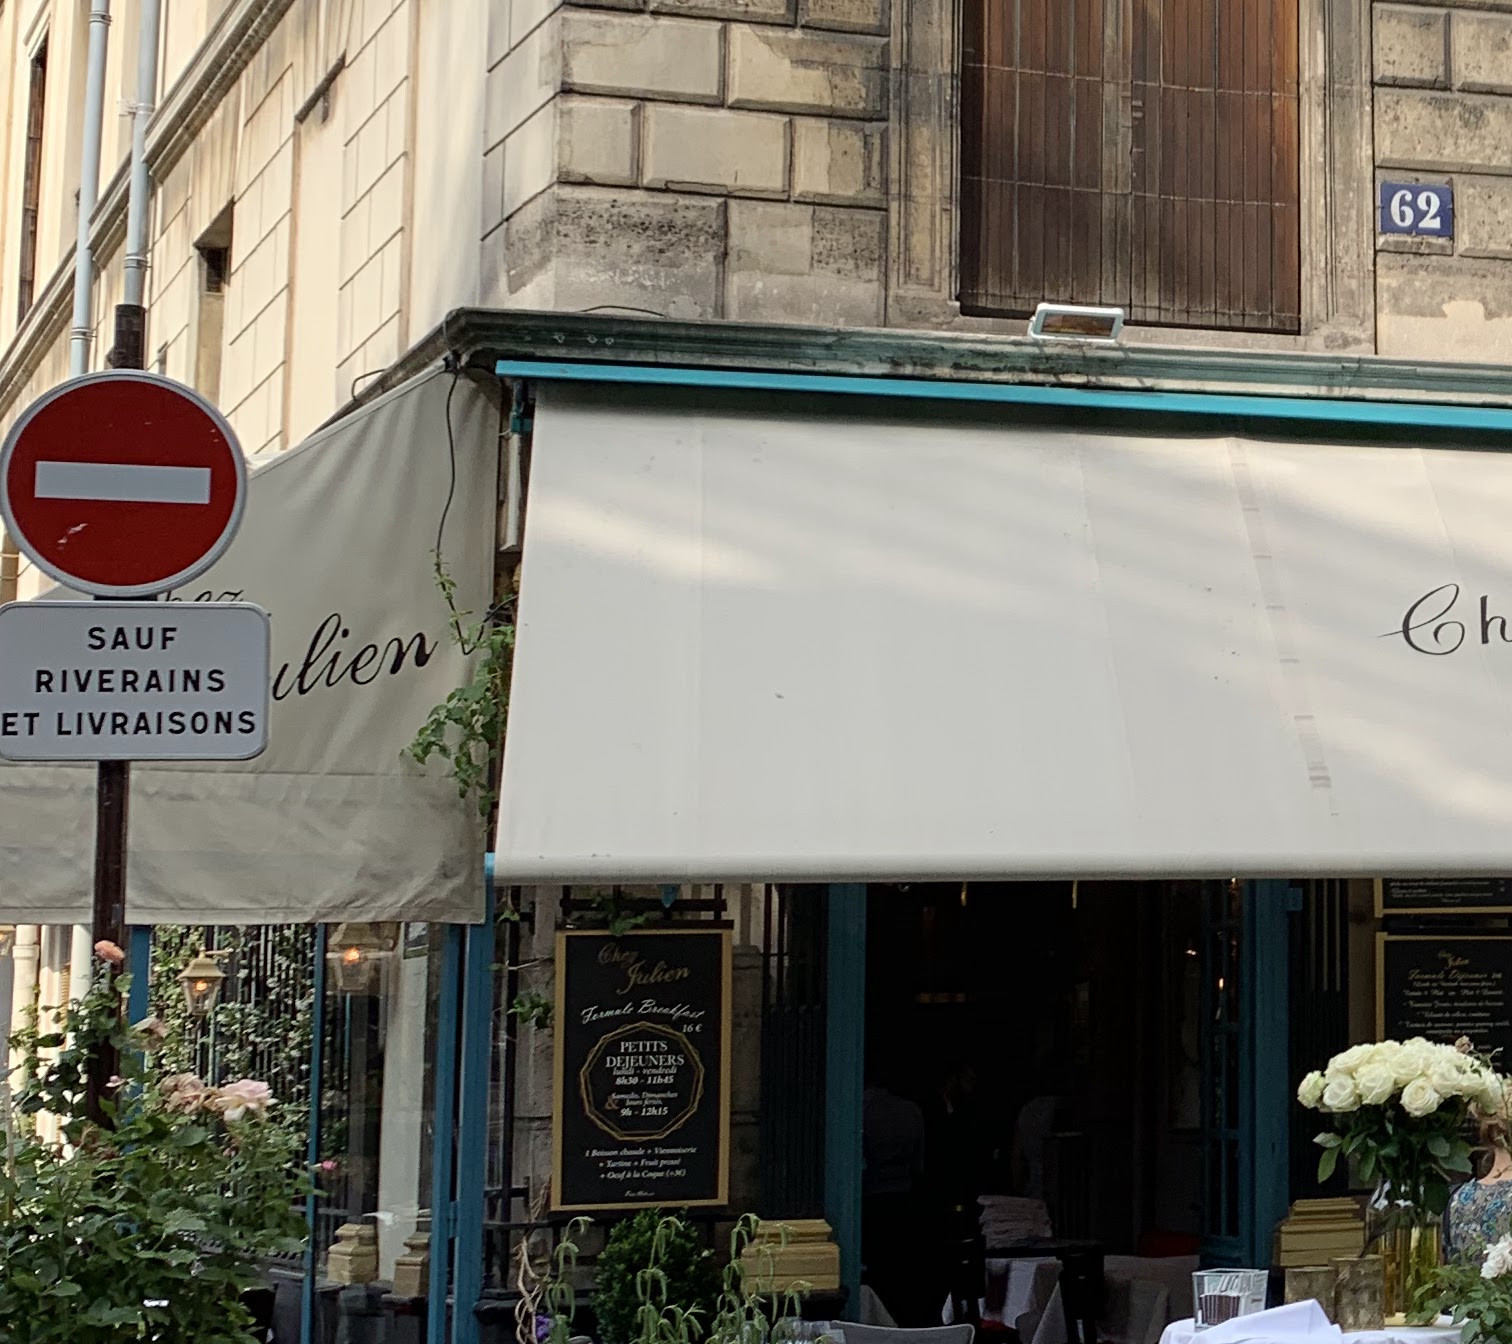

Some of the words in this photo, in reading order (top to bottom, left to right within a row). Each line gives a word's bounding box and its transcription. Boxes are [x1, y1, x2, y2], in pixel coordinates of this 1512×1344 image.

[1390, 189, 1442, 229] 62
[87, 626, 178, 651] SAUF
[268, 613, 439, 701] lien
[35, 668, 226, 694] RIVERAINS
[1, 711, 40, 737] ET
[56, 710, 257, 737] LIVRAISONS
[598, 942, 639, 968] Chez
[616, 960, 691, 995] Julien
[636, 999, 706, 1021] Breakfast
[620, 1041, 668, 1053] PETITS
[605, 1054, 685, 1068] DEJEUNERS
[641, 1107, 668, 1116] 12h15
